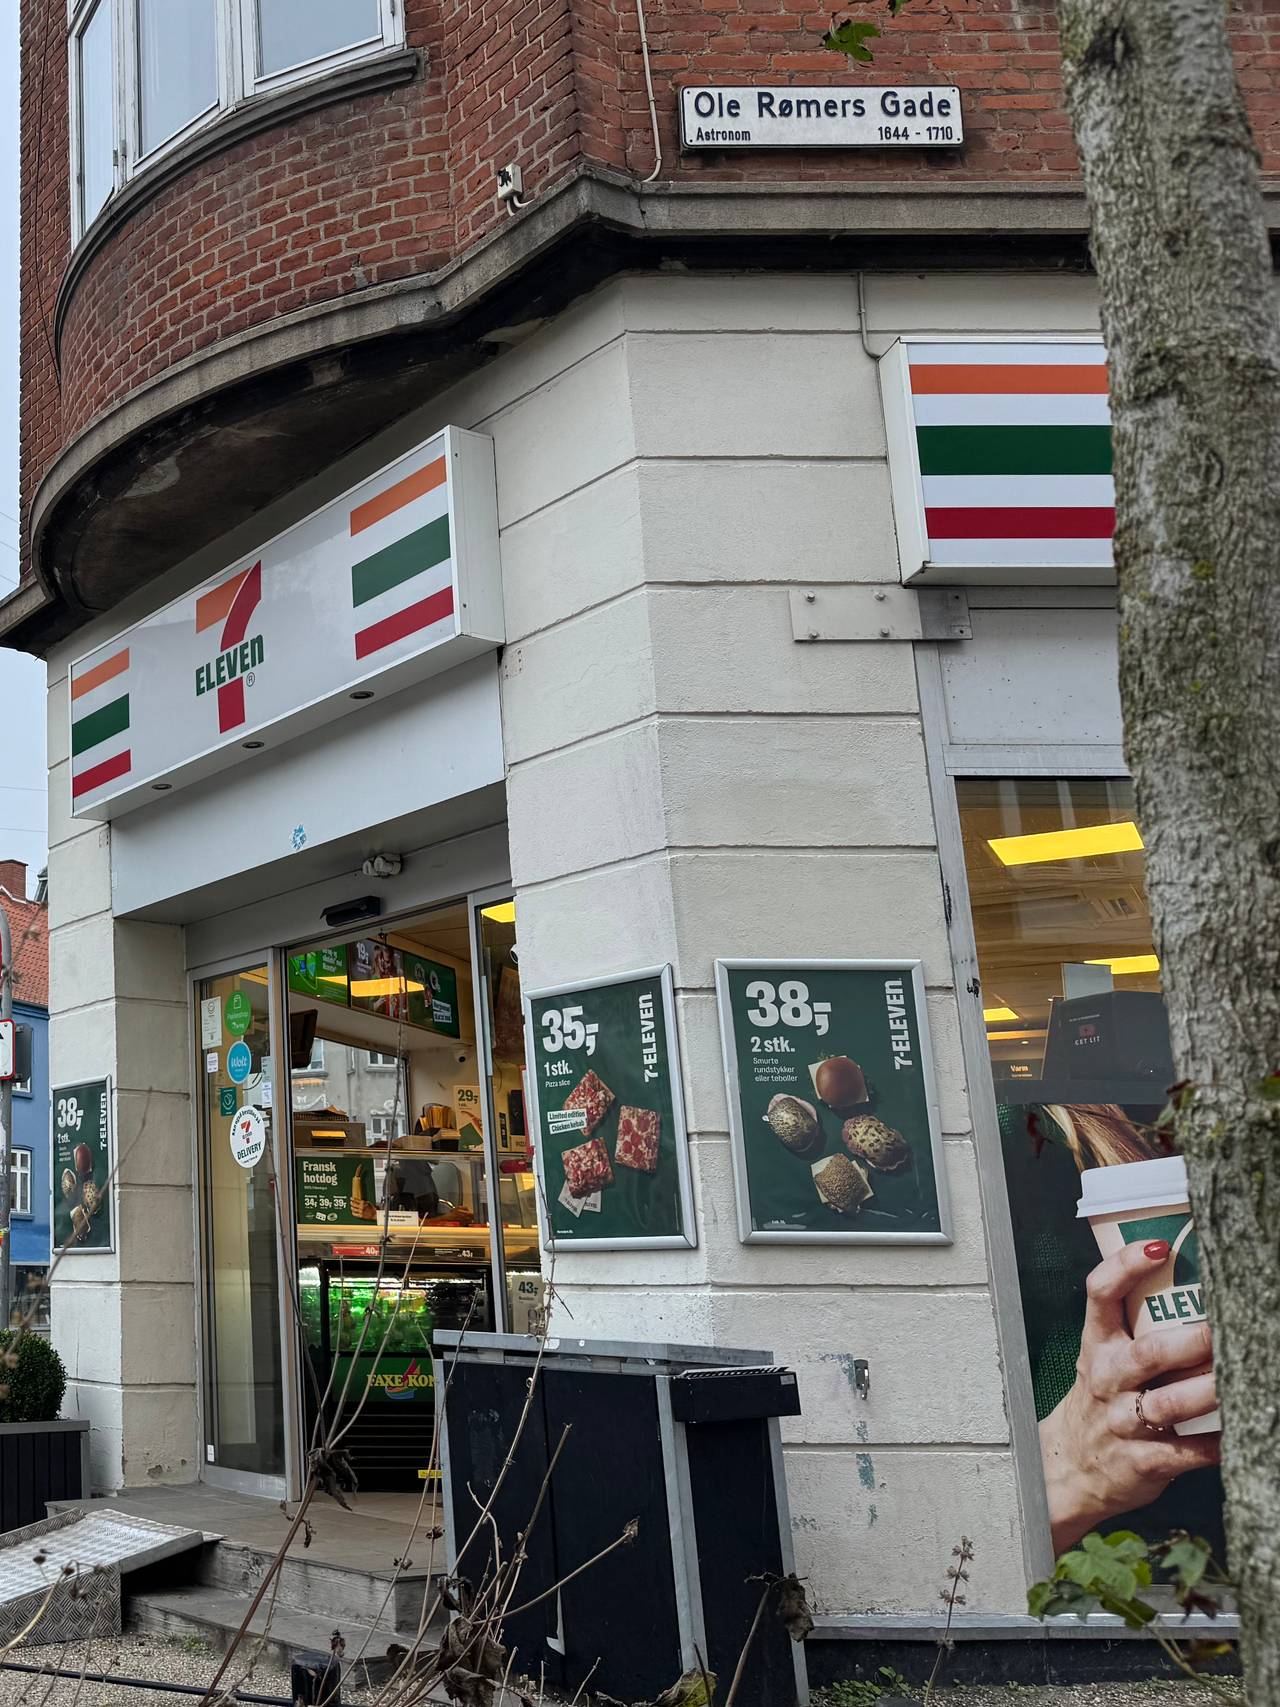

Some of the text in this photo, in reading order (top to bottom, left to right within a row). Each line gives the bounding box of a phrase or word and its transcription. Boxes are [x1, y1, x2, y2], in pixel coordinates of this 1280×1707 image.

[694, 90, 952, 119] Ole Rømers Gade
[696, 127, 751, 142] Astronom
[878, 126, 910, 141] 1644
[926, 126, 953, 141] 1710
[750, 1036, 796, 1053] 2 stk.
[551, 1060, 573, 1076] stk.
[755, 1074, 770, 1082] eller
[549, 1110, 586, 1120] Limited edition
[551, 1123, 571, 1132] Chicken
[237, 1141, 262, 1160] DELIVERY
[303, 1161, 336, 1172] Fransk
[303, 1172, 338, 1186] hotdog
[1144, 1289, 1206, 1323] ELEV
